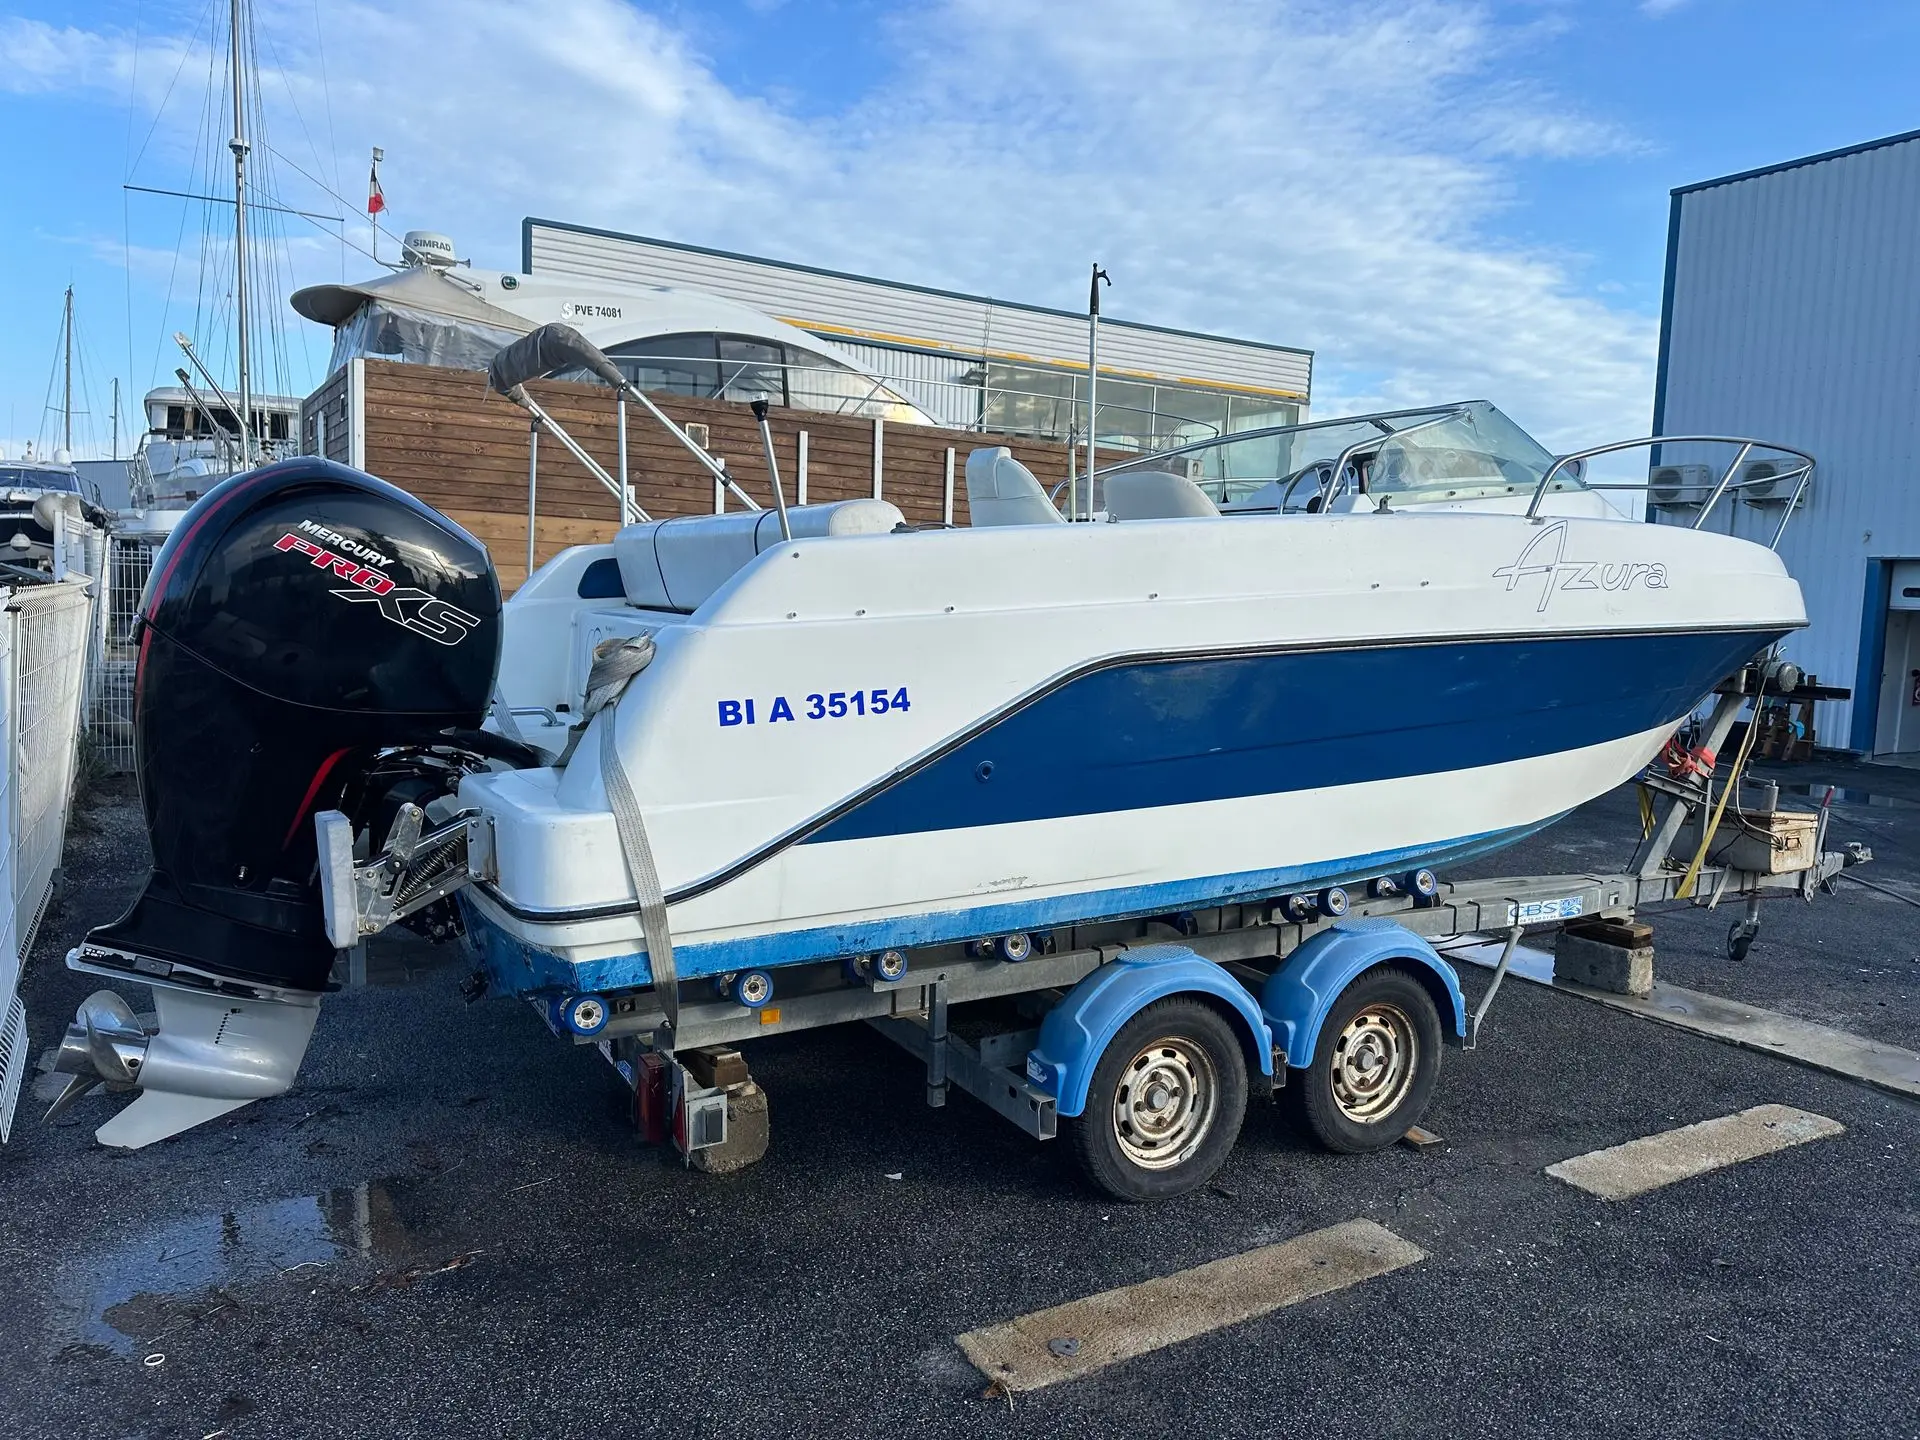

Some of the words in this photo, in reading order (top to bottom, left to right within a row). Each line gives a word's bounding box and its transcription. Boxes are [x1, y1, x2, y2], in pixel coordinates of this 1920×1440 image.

[413, 238, 451, 252] SIMRAD
[574, 304, 594, 317] PVE
[595, 306, 622, 319] 74081
[273, 532, 396, 596] PRO
[297, 519, 396, 568] MERCURY
[1492, 520, 1669, 612] Azura
[328, 587, 481, 646] XS
[718, 698, 756, 727] BI
[769, 696, 795, 723] A
[806, 687, 911, 720] 35154
